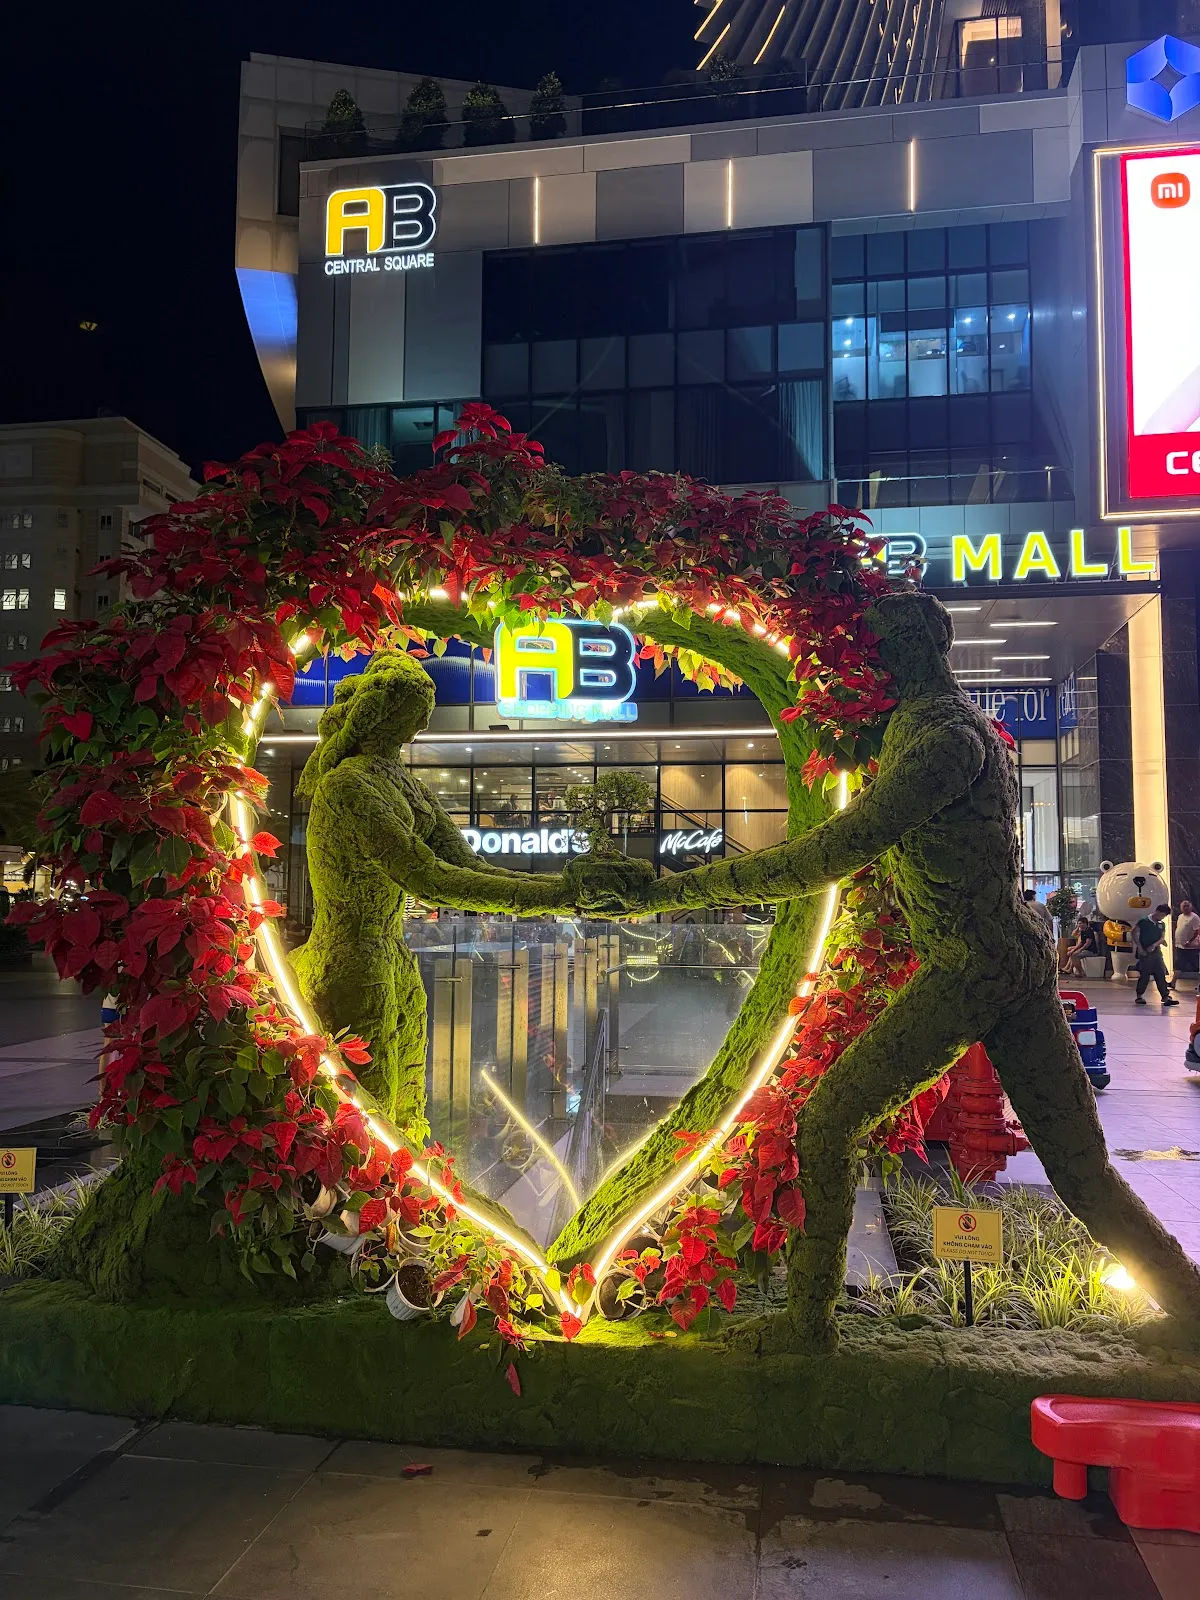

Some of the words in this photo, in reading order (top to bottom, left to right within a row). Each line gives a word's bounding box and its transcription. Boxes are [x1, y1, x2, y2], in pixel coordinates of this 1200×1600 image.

[325, 182, 436, 256] AB
[324, 258, 381, 276] CENTRAL
[384, 252, 435, 271] SQUARE
[951, 526, 1157, 582] MALL
[495, 618, 637, 704] AB
